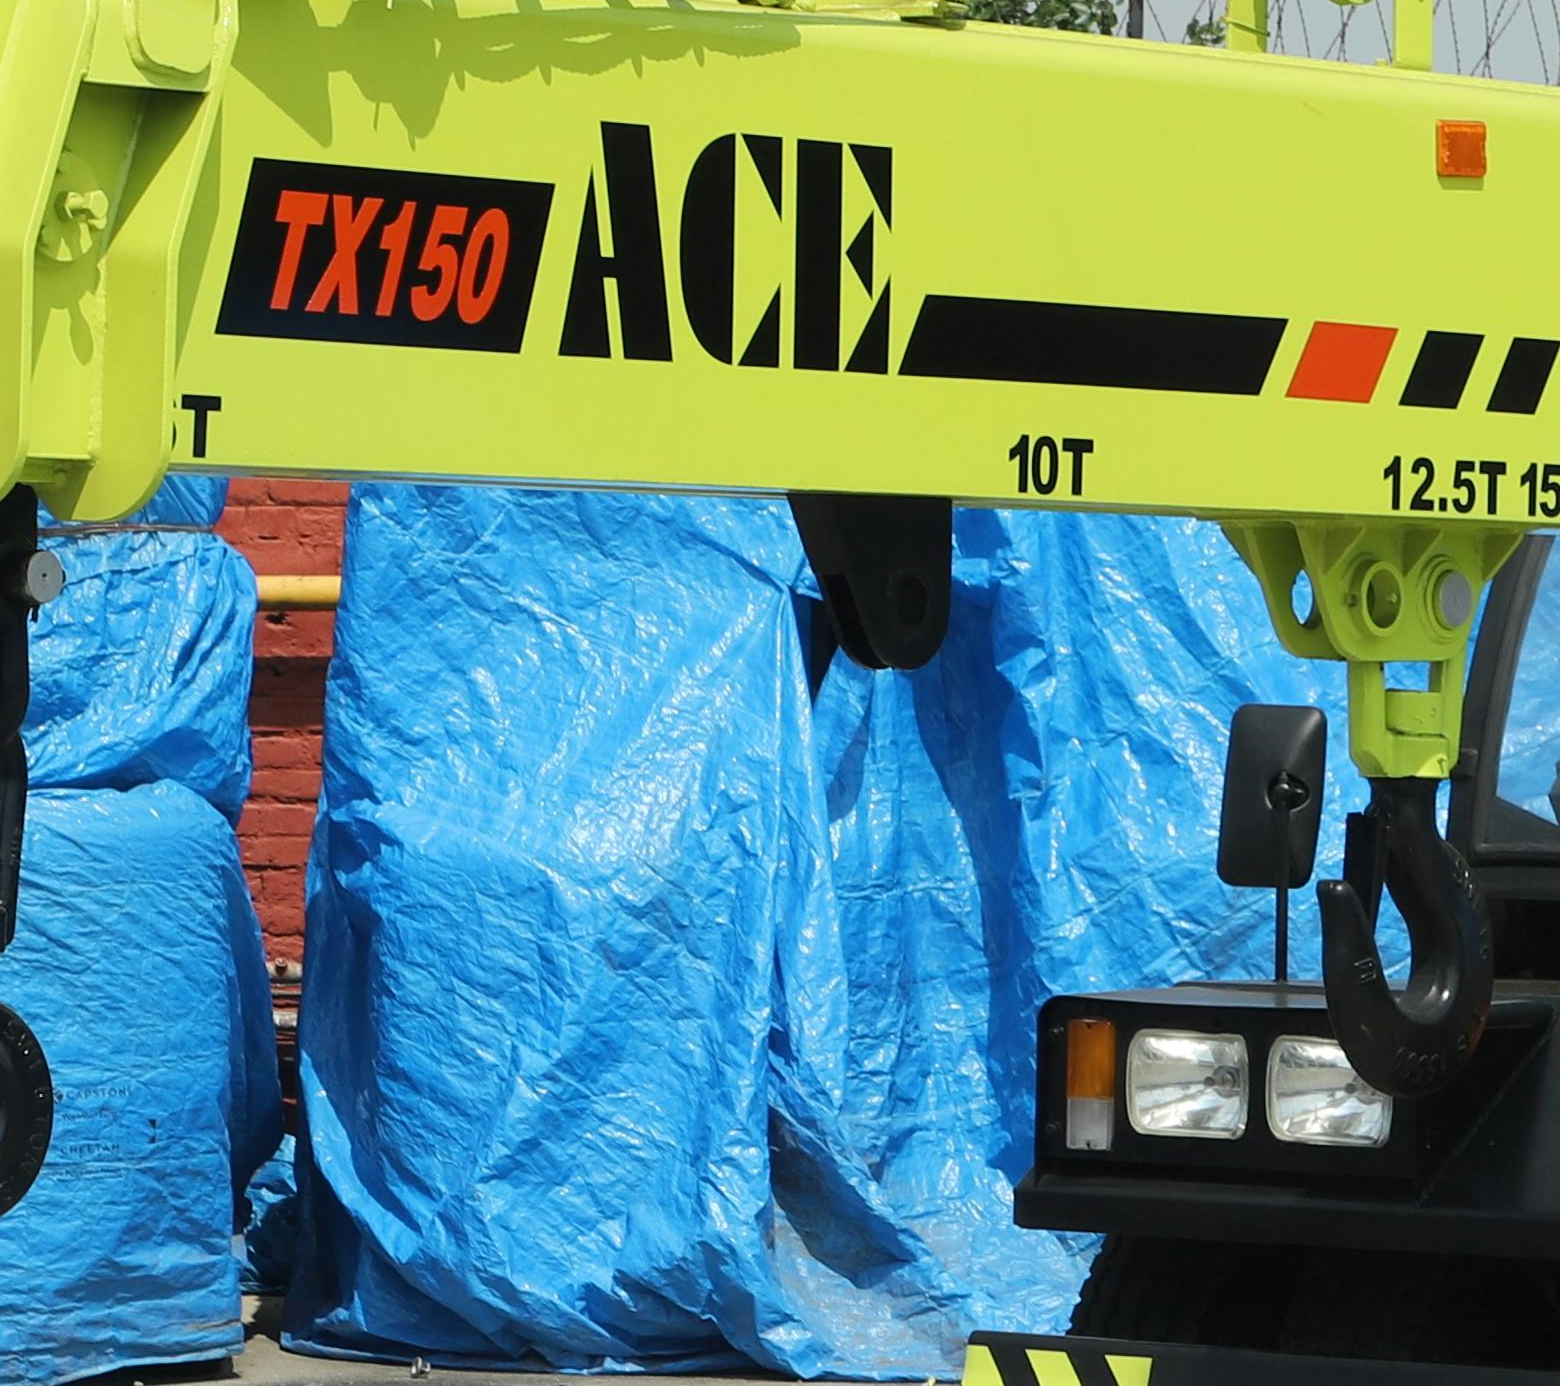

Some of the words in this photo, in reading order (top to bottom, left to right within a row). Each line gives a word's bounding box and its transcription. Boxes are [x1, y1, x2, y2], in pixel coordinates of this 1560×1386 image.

[269, 189, 511, 325] TX150
[558, 120, 893, 376] ACE
[172, 394, 222, 459] T
[1008, 434, 1094, 496] 10T
[1383, 455, 1507, 515] 12.5T
